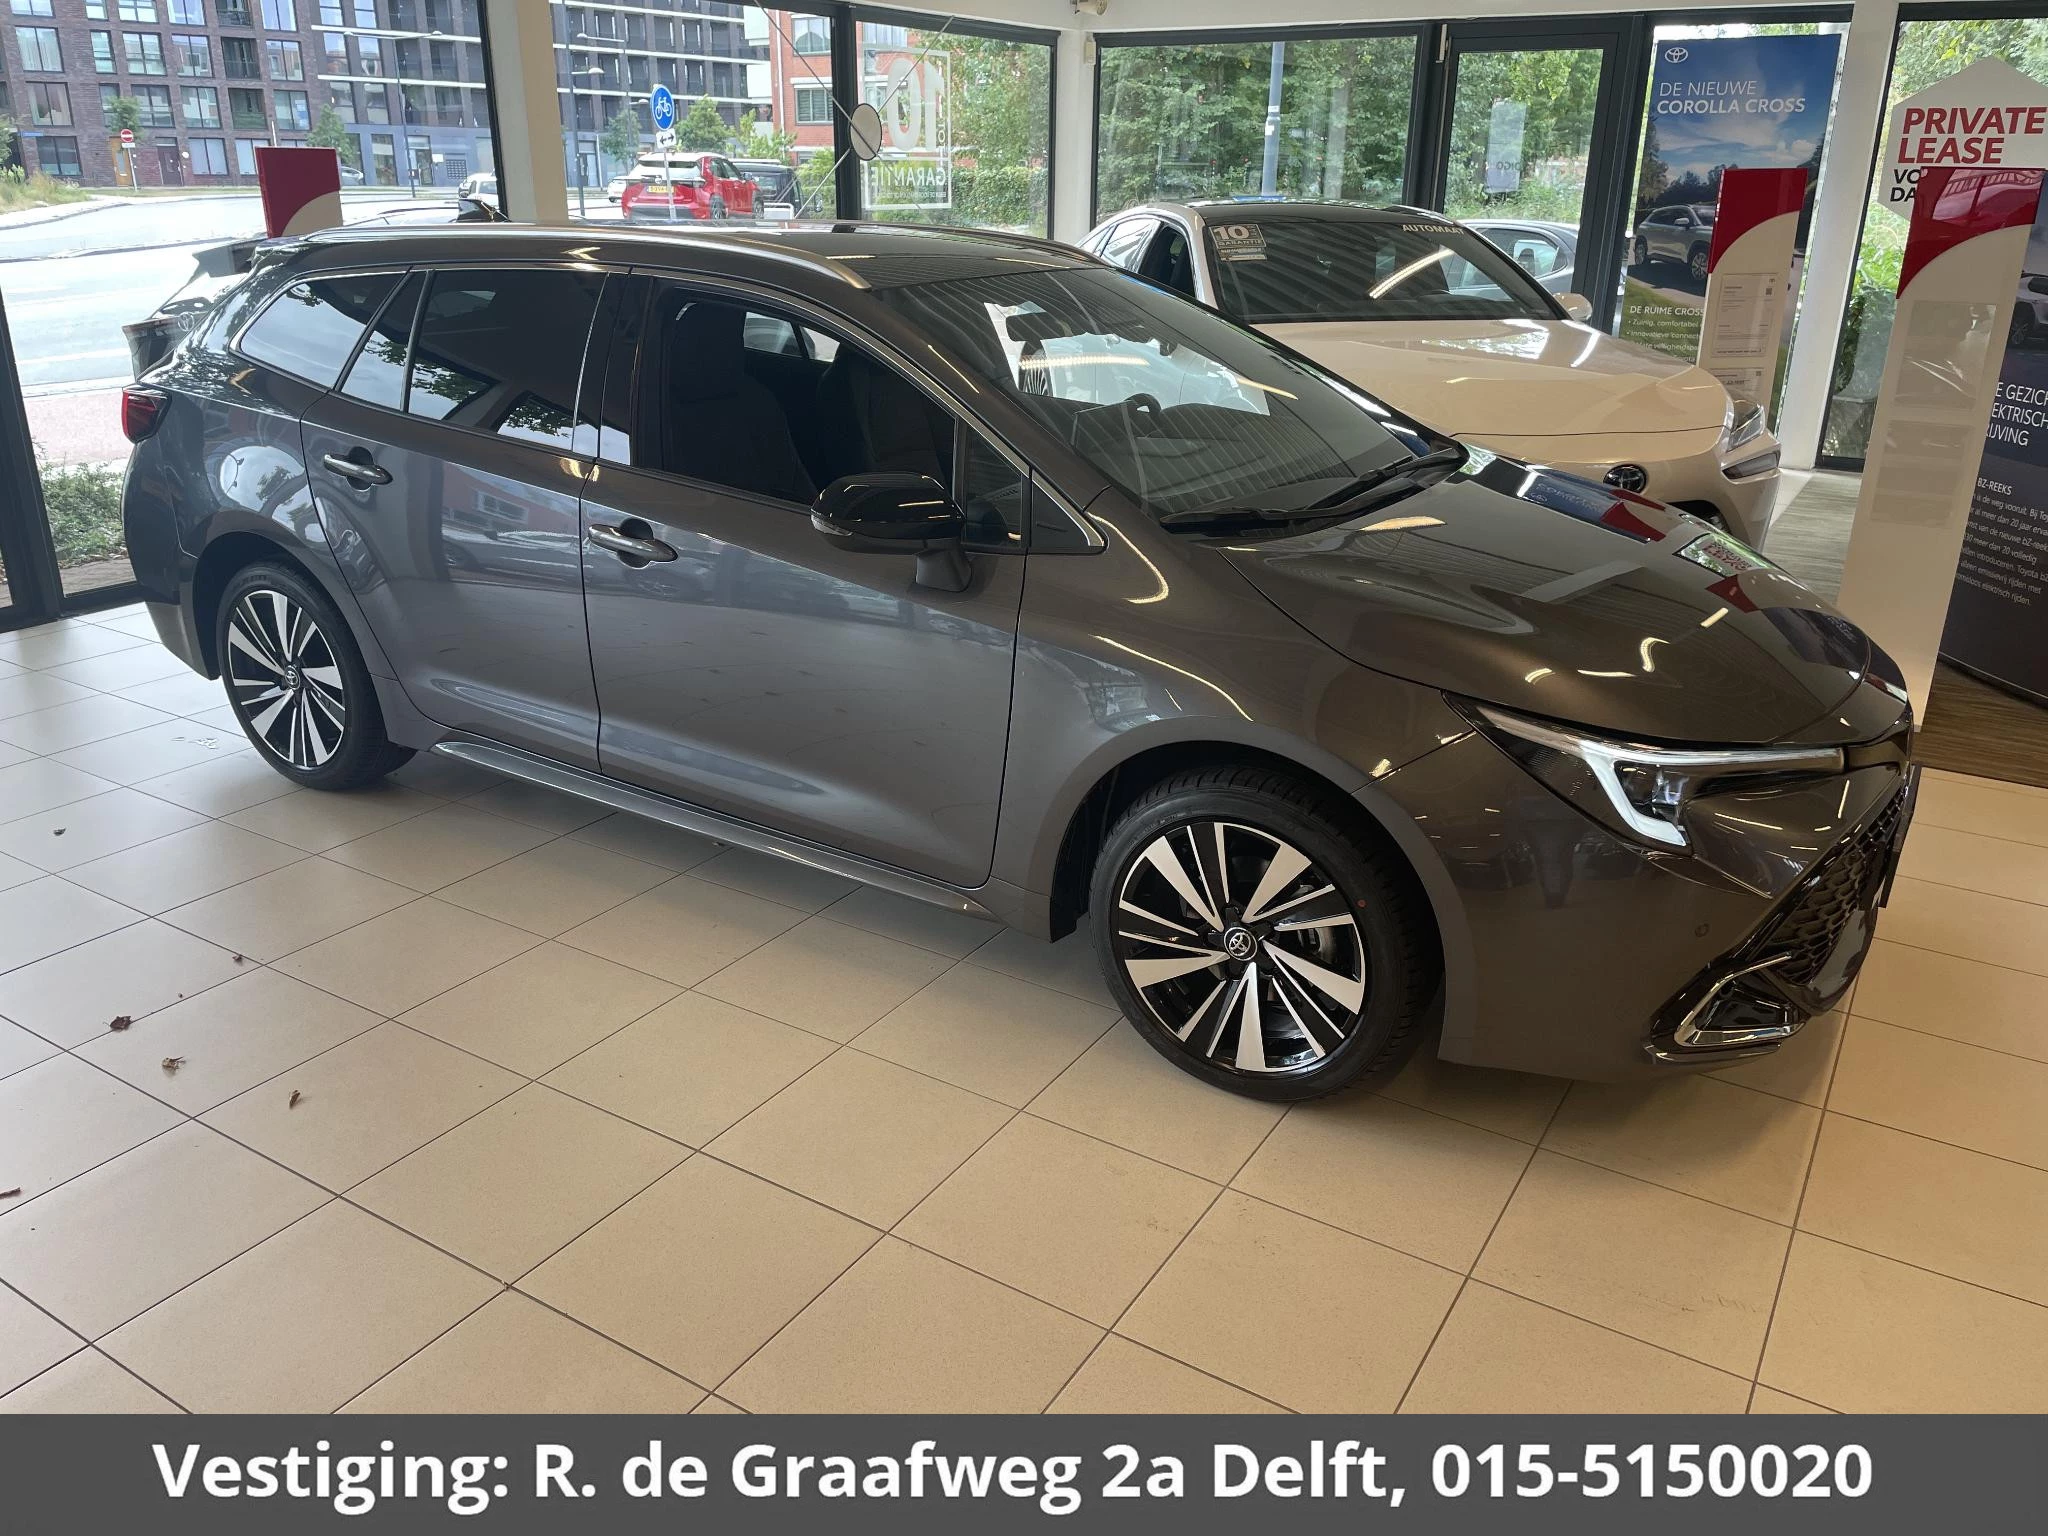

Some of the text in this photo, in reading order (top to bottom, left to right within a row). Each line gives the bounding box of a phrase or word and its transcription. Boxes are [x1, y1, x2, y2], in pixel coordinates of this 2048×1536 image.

[1660, 81, 1757, 96] DE NIEUWE
[1657, 98, 1806, 114] COROLLA CROSS
[1903, 107, 2048, 134] PRIVATE
[1898, 137, 2004, 164] LEASE
[1213, 226, 1249, 239] 10
[1403, 224, 1464, 234] AUTOMAAT
[1630, 306, 1704, 316] DE RUIME CROSS
[1986, 423, 2029, 446] IJVING
